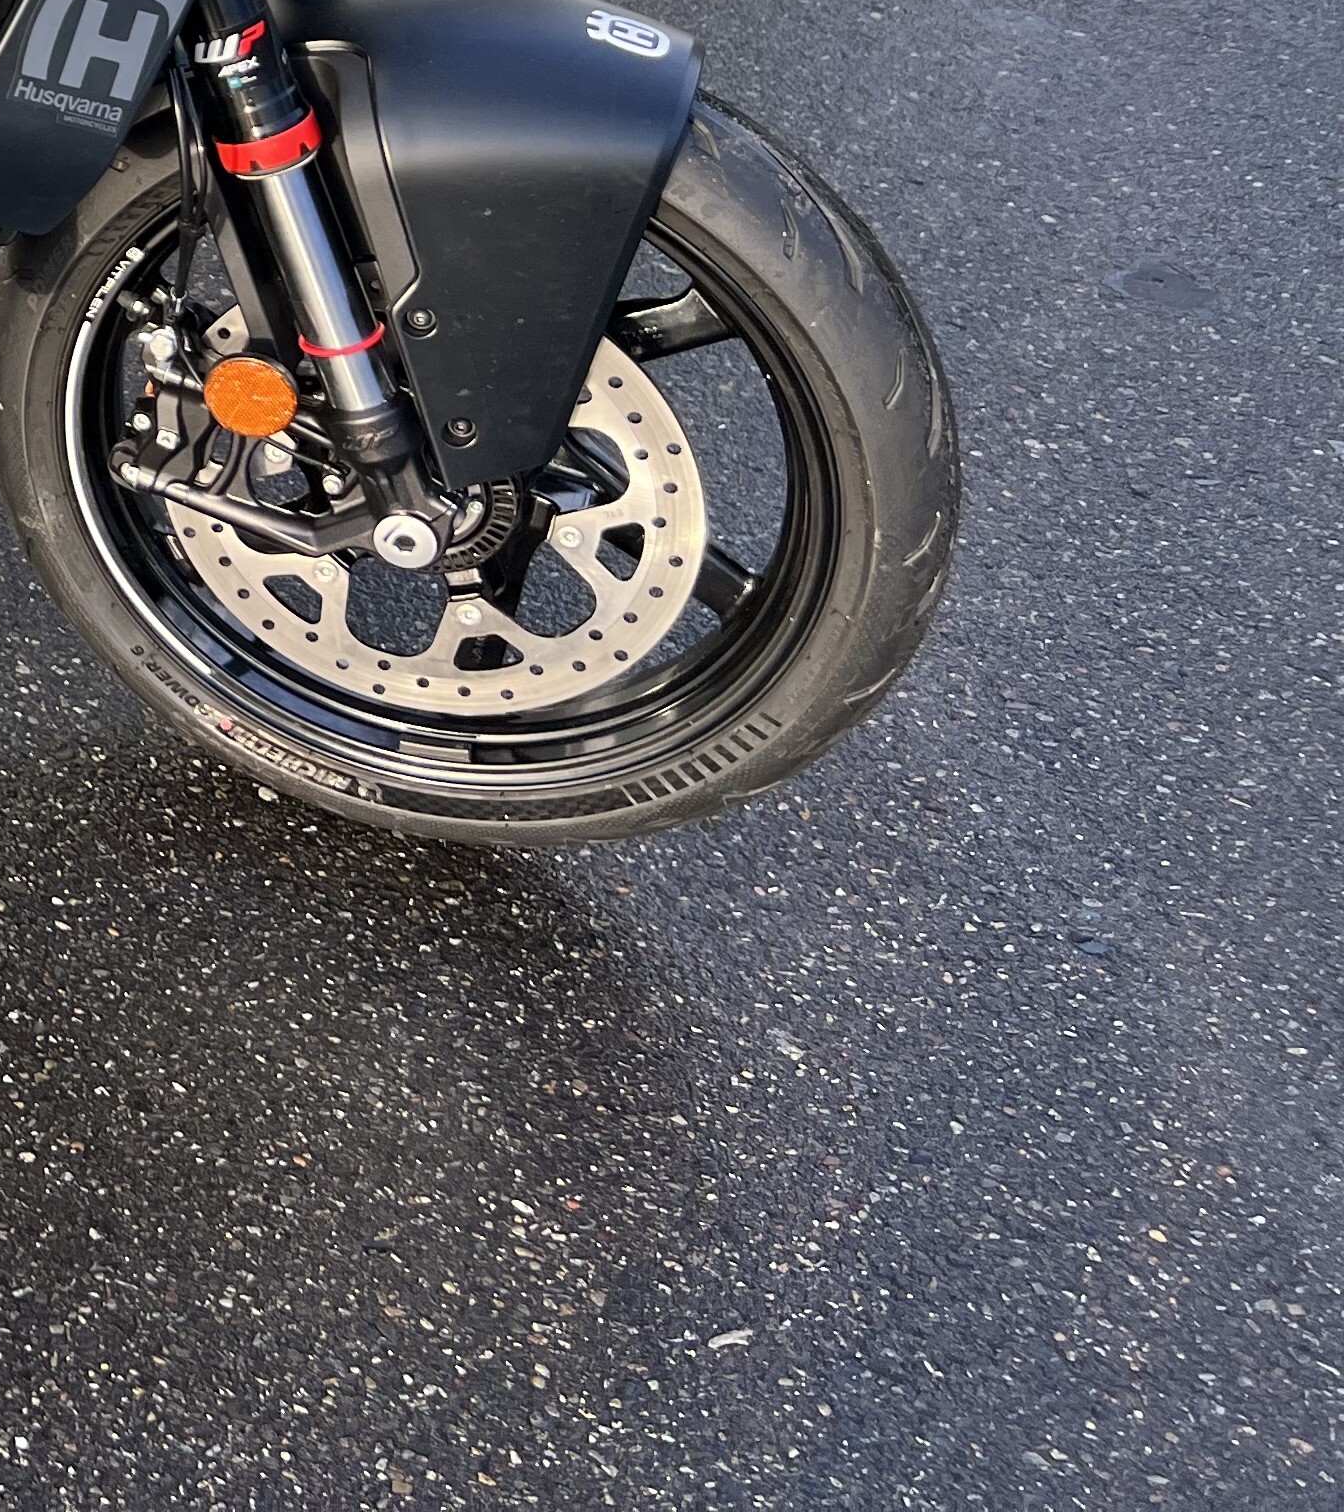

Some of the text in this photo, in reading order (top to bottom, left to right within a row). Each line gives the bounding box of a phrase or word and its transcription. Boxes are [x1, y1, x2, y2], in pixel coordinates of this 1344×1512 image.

[217, 55, 261, 78] APEX
[13, 78, 124, 123] Husqvarna
[85, 260, 131, 319] VITPILEN
